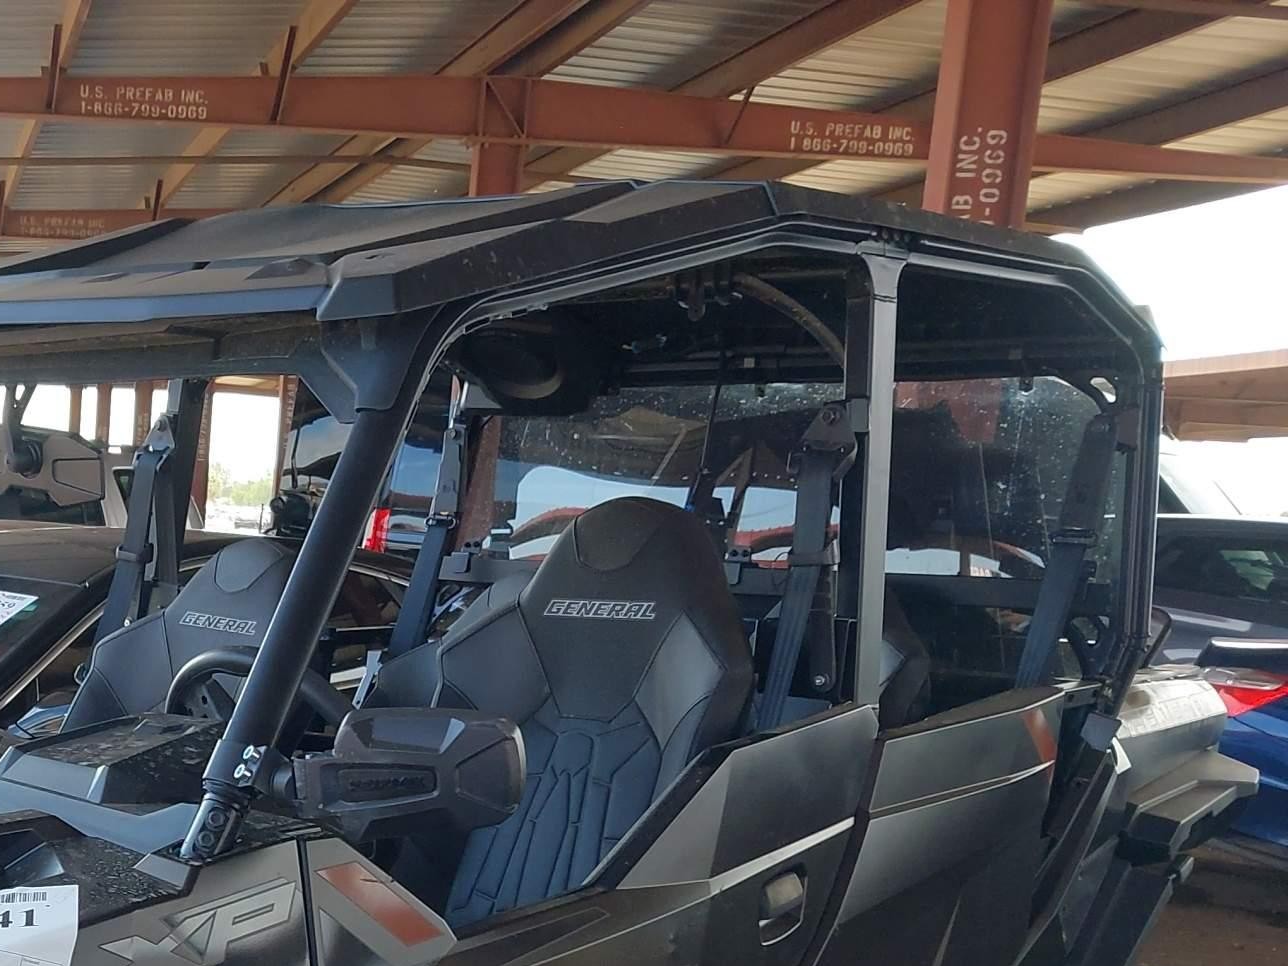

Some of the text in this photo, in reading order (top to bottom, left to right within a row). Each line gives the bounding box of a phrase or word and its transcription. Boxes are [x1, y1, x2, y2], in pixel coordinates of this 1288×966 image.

[80, 84, 209, 105] U.S. PREFAB INC.
[80, 101, 208, 120] 1-866-799-0969
[790, 120, 915, 141] U.S. PREFAB INC.
[955, 127, 983, 178] INC.
[543, 599, 656, 619] GENERAL
[179, 611, 256, 635] GENERAL
